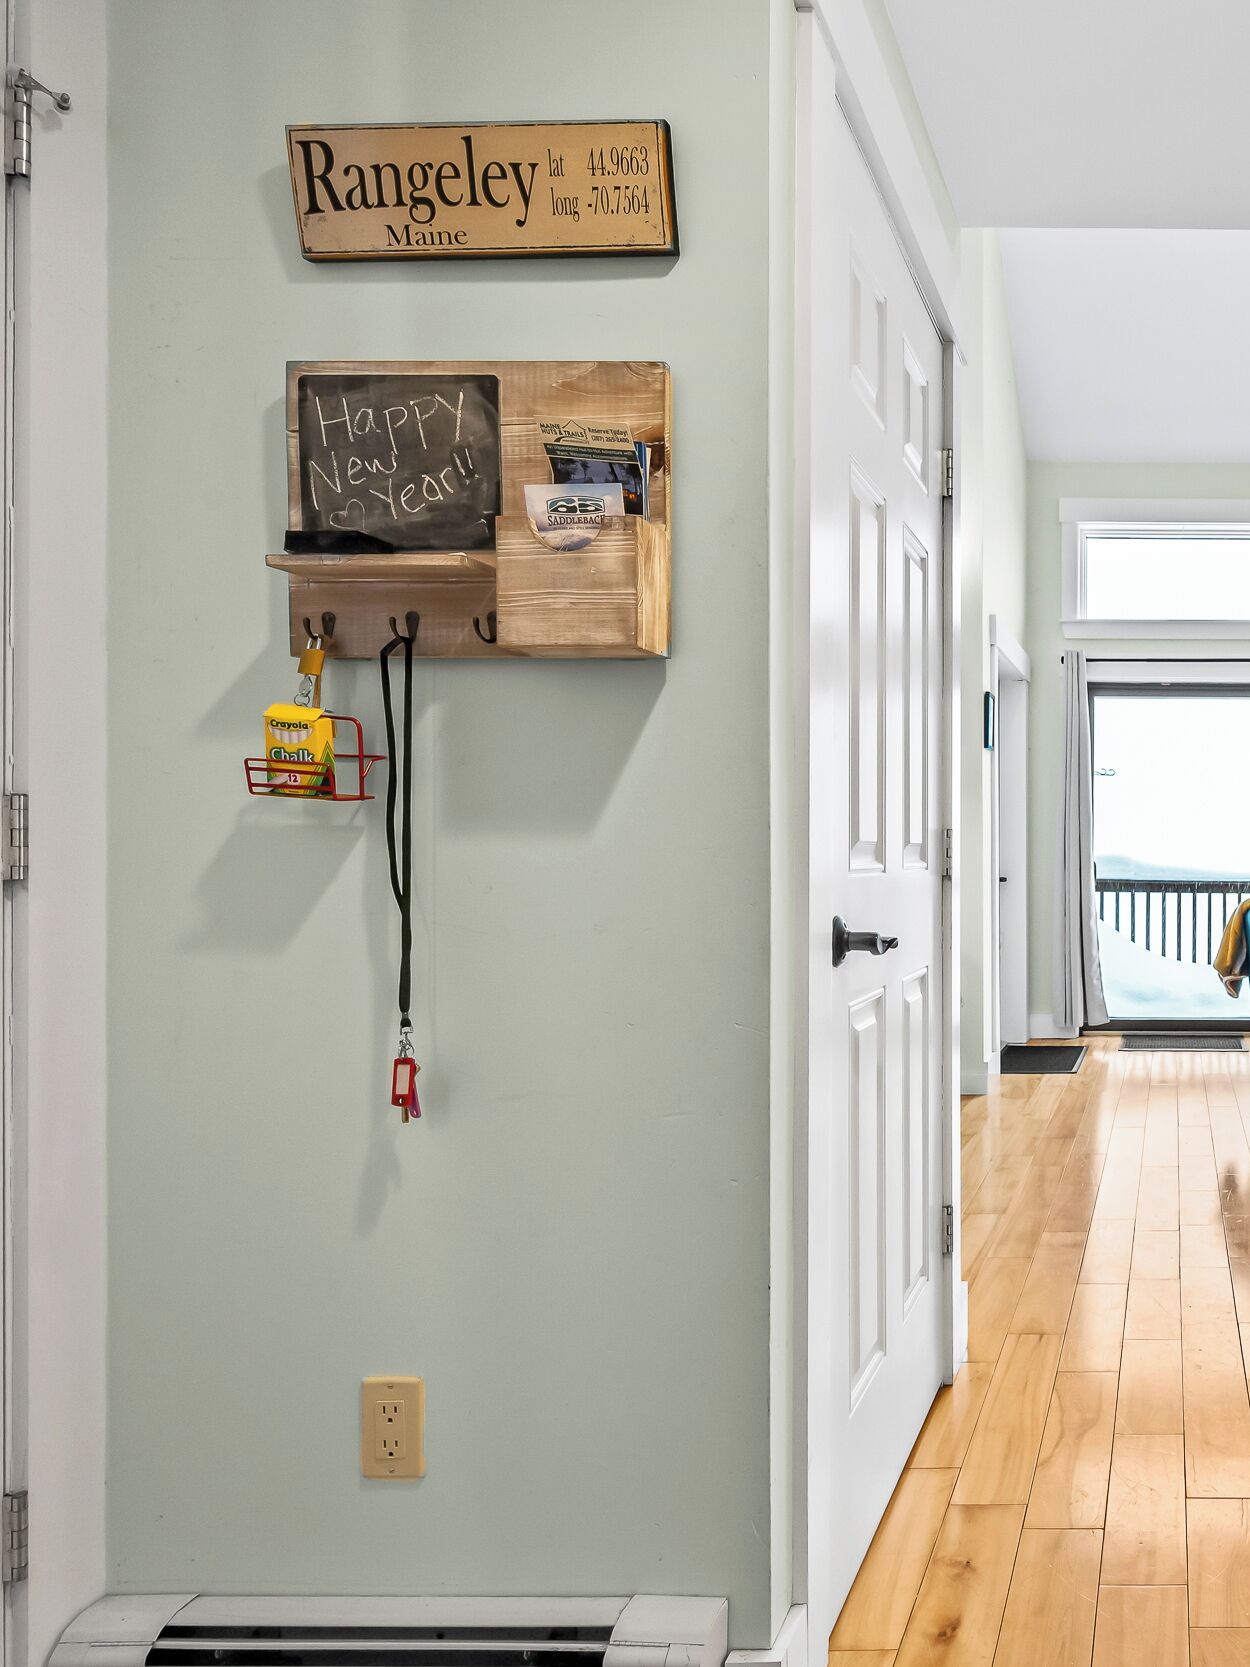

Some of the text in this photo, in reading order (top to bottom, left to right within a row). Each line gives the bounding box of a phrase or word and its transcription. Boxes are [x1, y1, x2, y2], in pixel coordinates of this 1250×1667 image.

[547, 145, 650, 178] lat 44.9663
[295, 134, 539, 227] Rangeley
[550, 184, 650, 222] long -70.7564
[384, 222, 468, 247] Maine
[308, 450, 397, 511] New
[270, 719, 309, 730] Crayola
[270, 747, 314, 763] Chalk
[288, 773, 299, 784] 12
